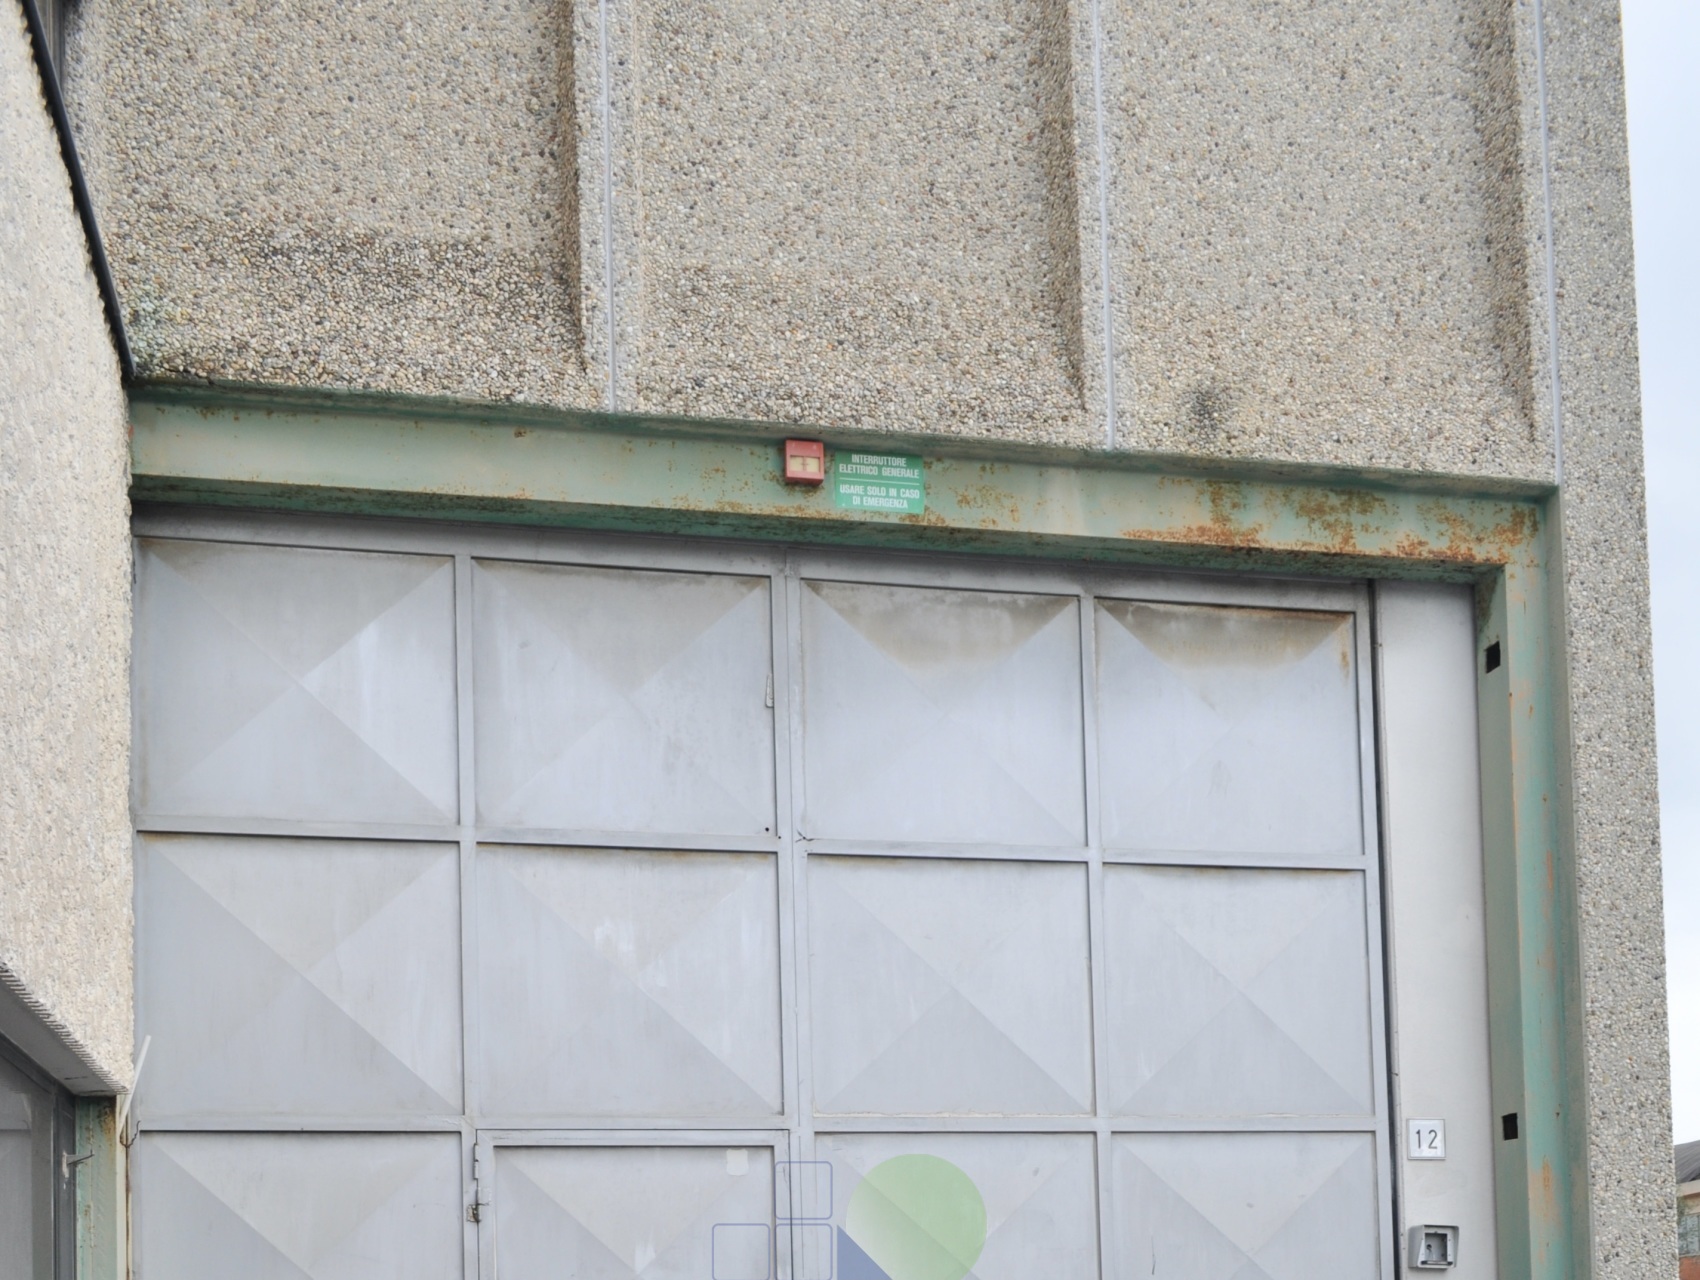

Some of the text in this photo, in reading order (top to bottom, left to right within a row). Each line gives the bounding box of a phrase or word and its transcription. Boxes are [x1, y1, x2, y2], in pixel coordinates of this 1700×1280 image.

[852, 454, 906, 467] INTERRUTTORE
[839, 464, 919, 478] ELETTRICO GENERALE
[840, 484, 920, 499] USARE SOLO IN CASO
[853, 496, 908, 508] DI EMERGENZA
[1416, 1129, 1438, 1149] 12
